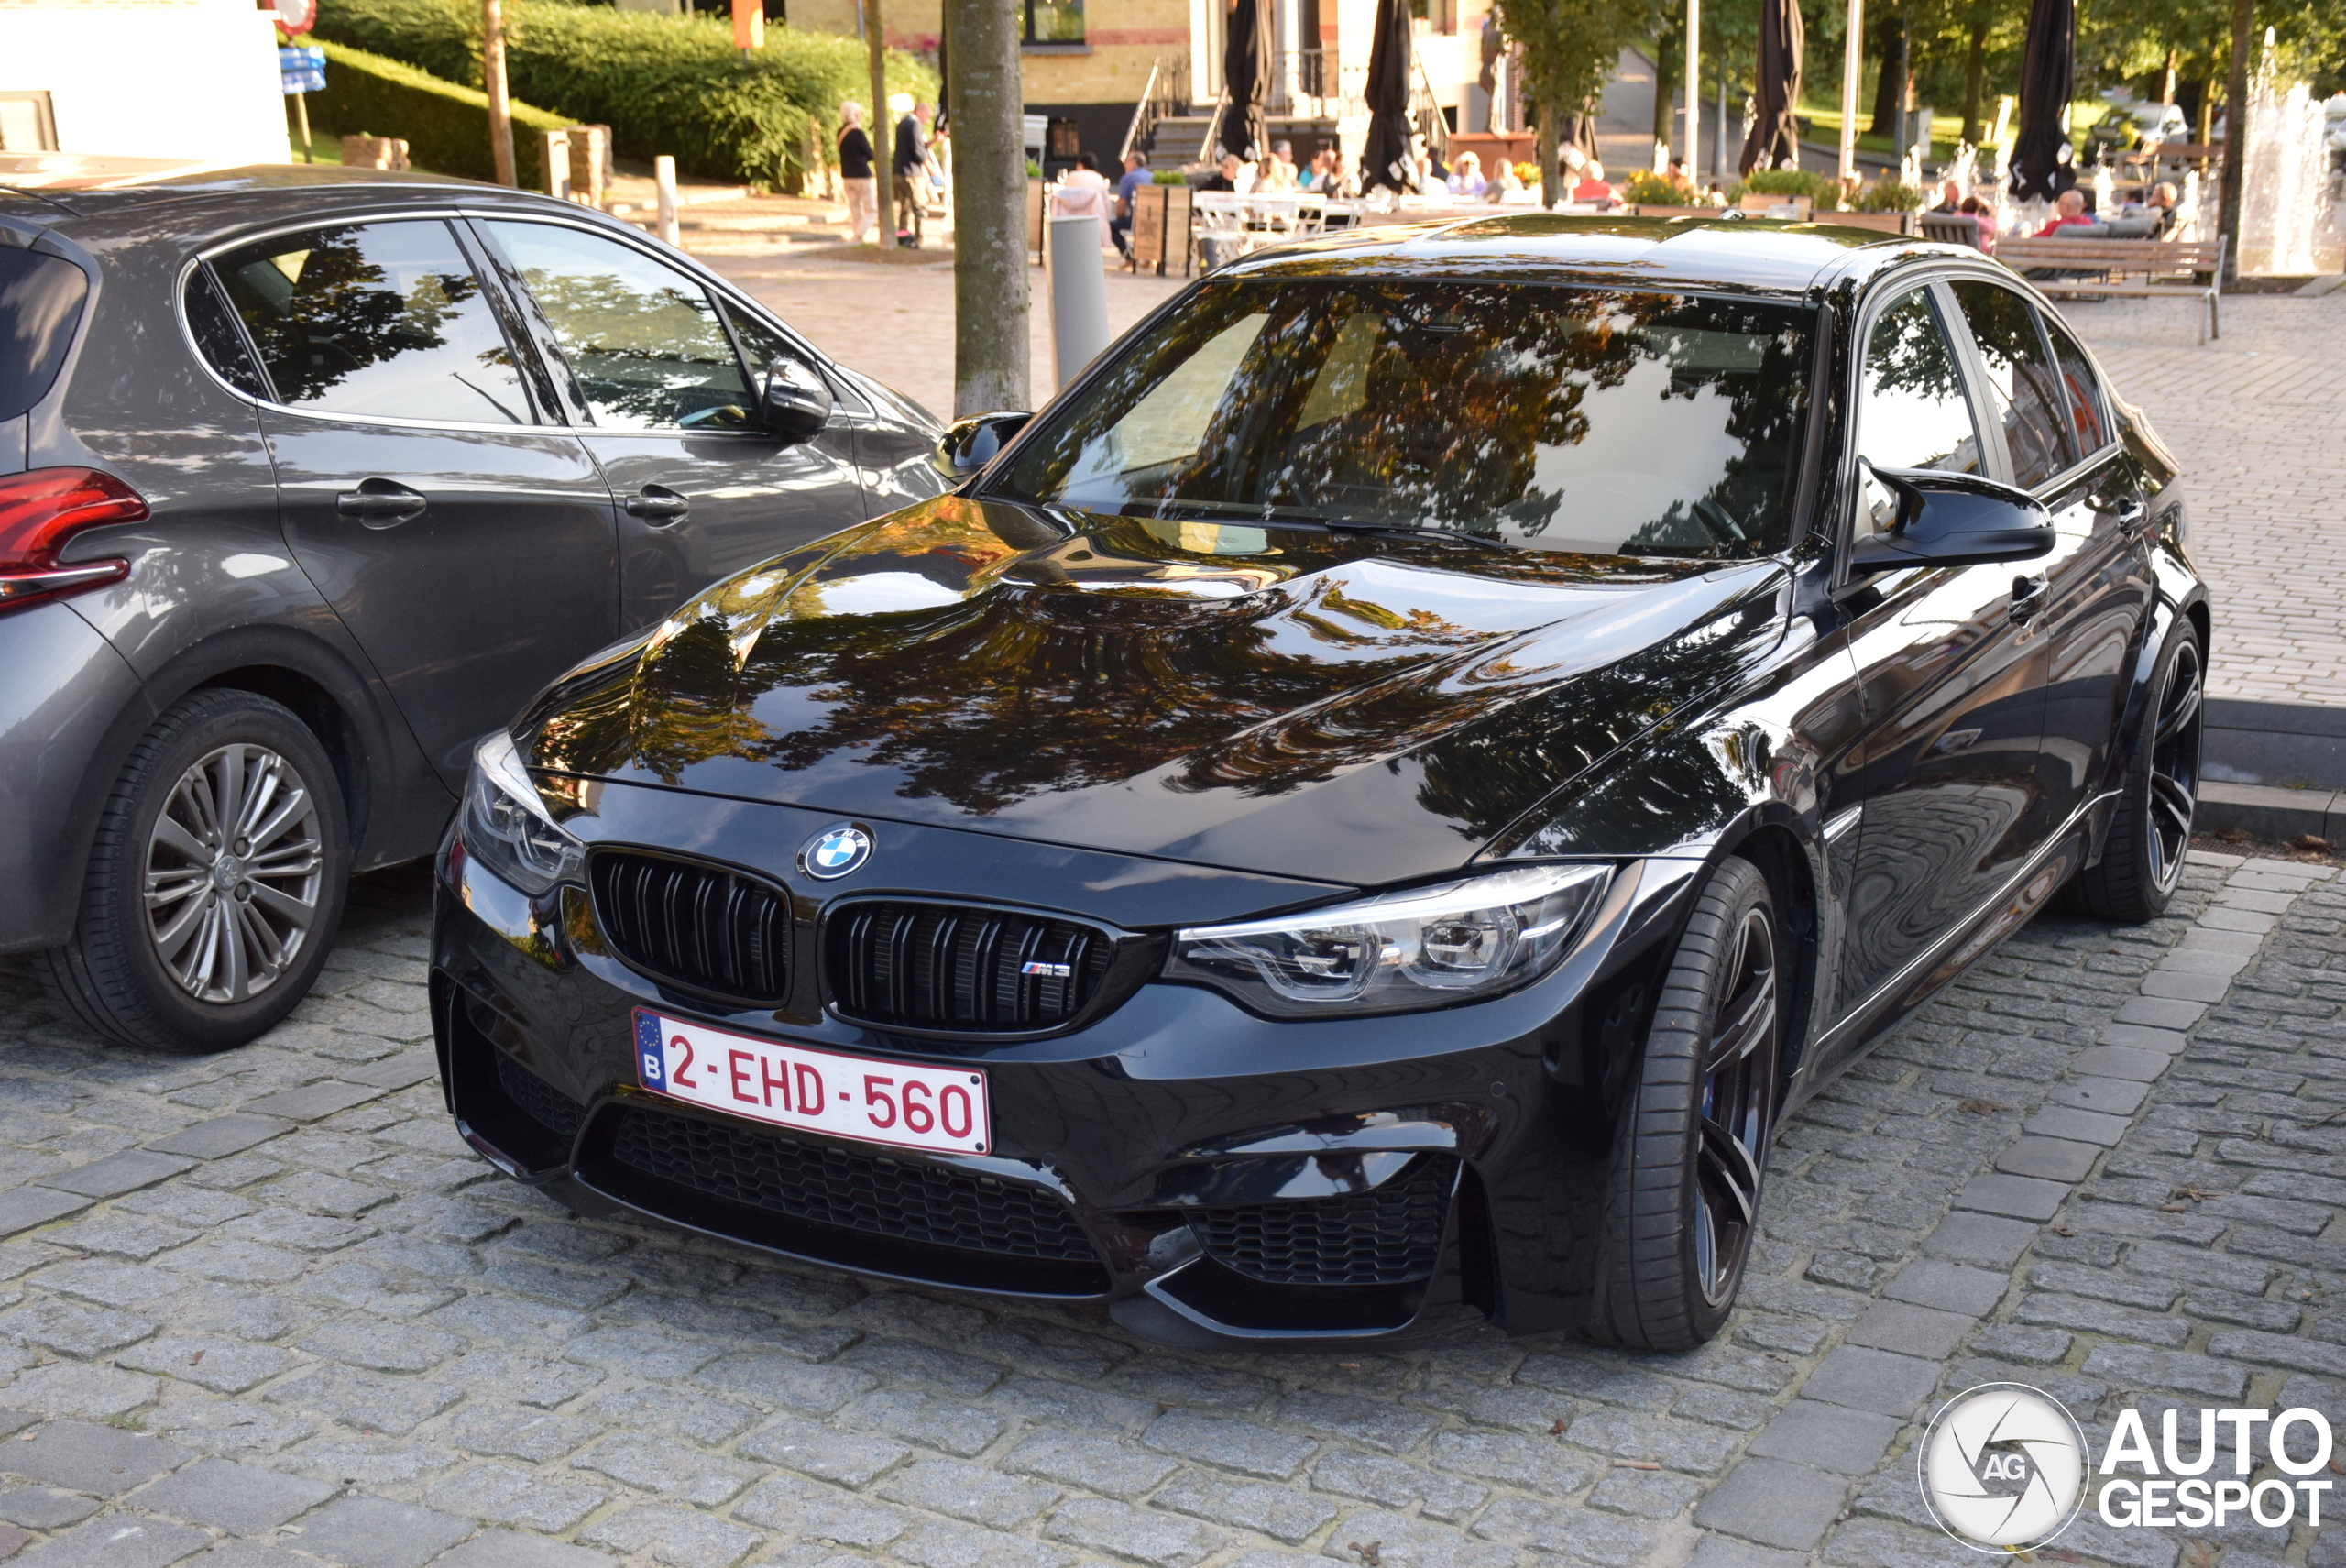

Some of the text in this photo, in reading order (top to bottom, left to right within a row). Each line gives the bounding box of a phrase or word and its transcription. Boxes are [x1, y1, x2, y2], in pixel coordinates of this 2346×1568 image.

[822, 829, 868, 848] BMW
[1033, 962, 1070, 977] M3
[643, 1054, 661, 1080] B
[669, 1035, 973, 1138] 2-EHD-560
